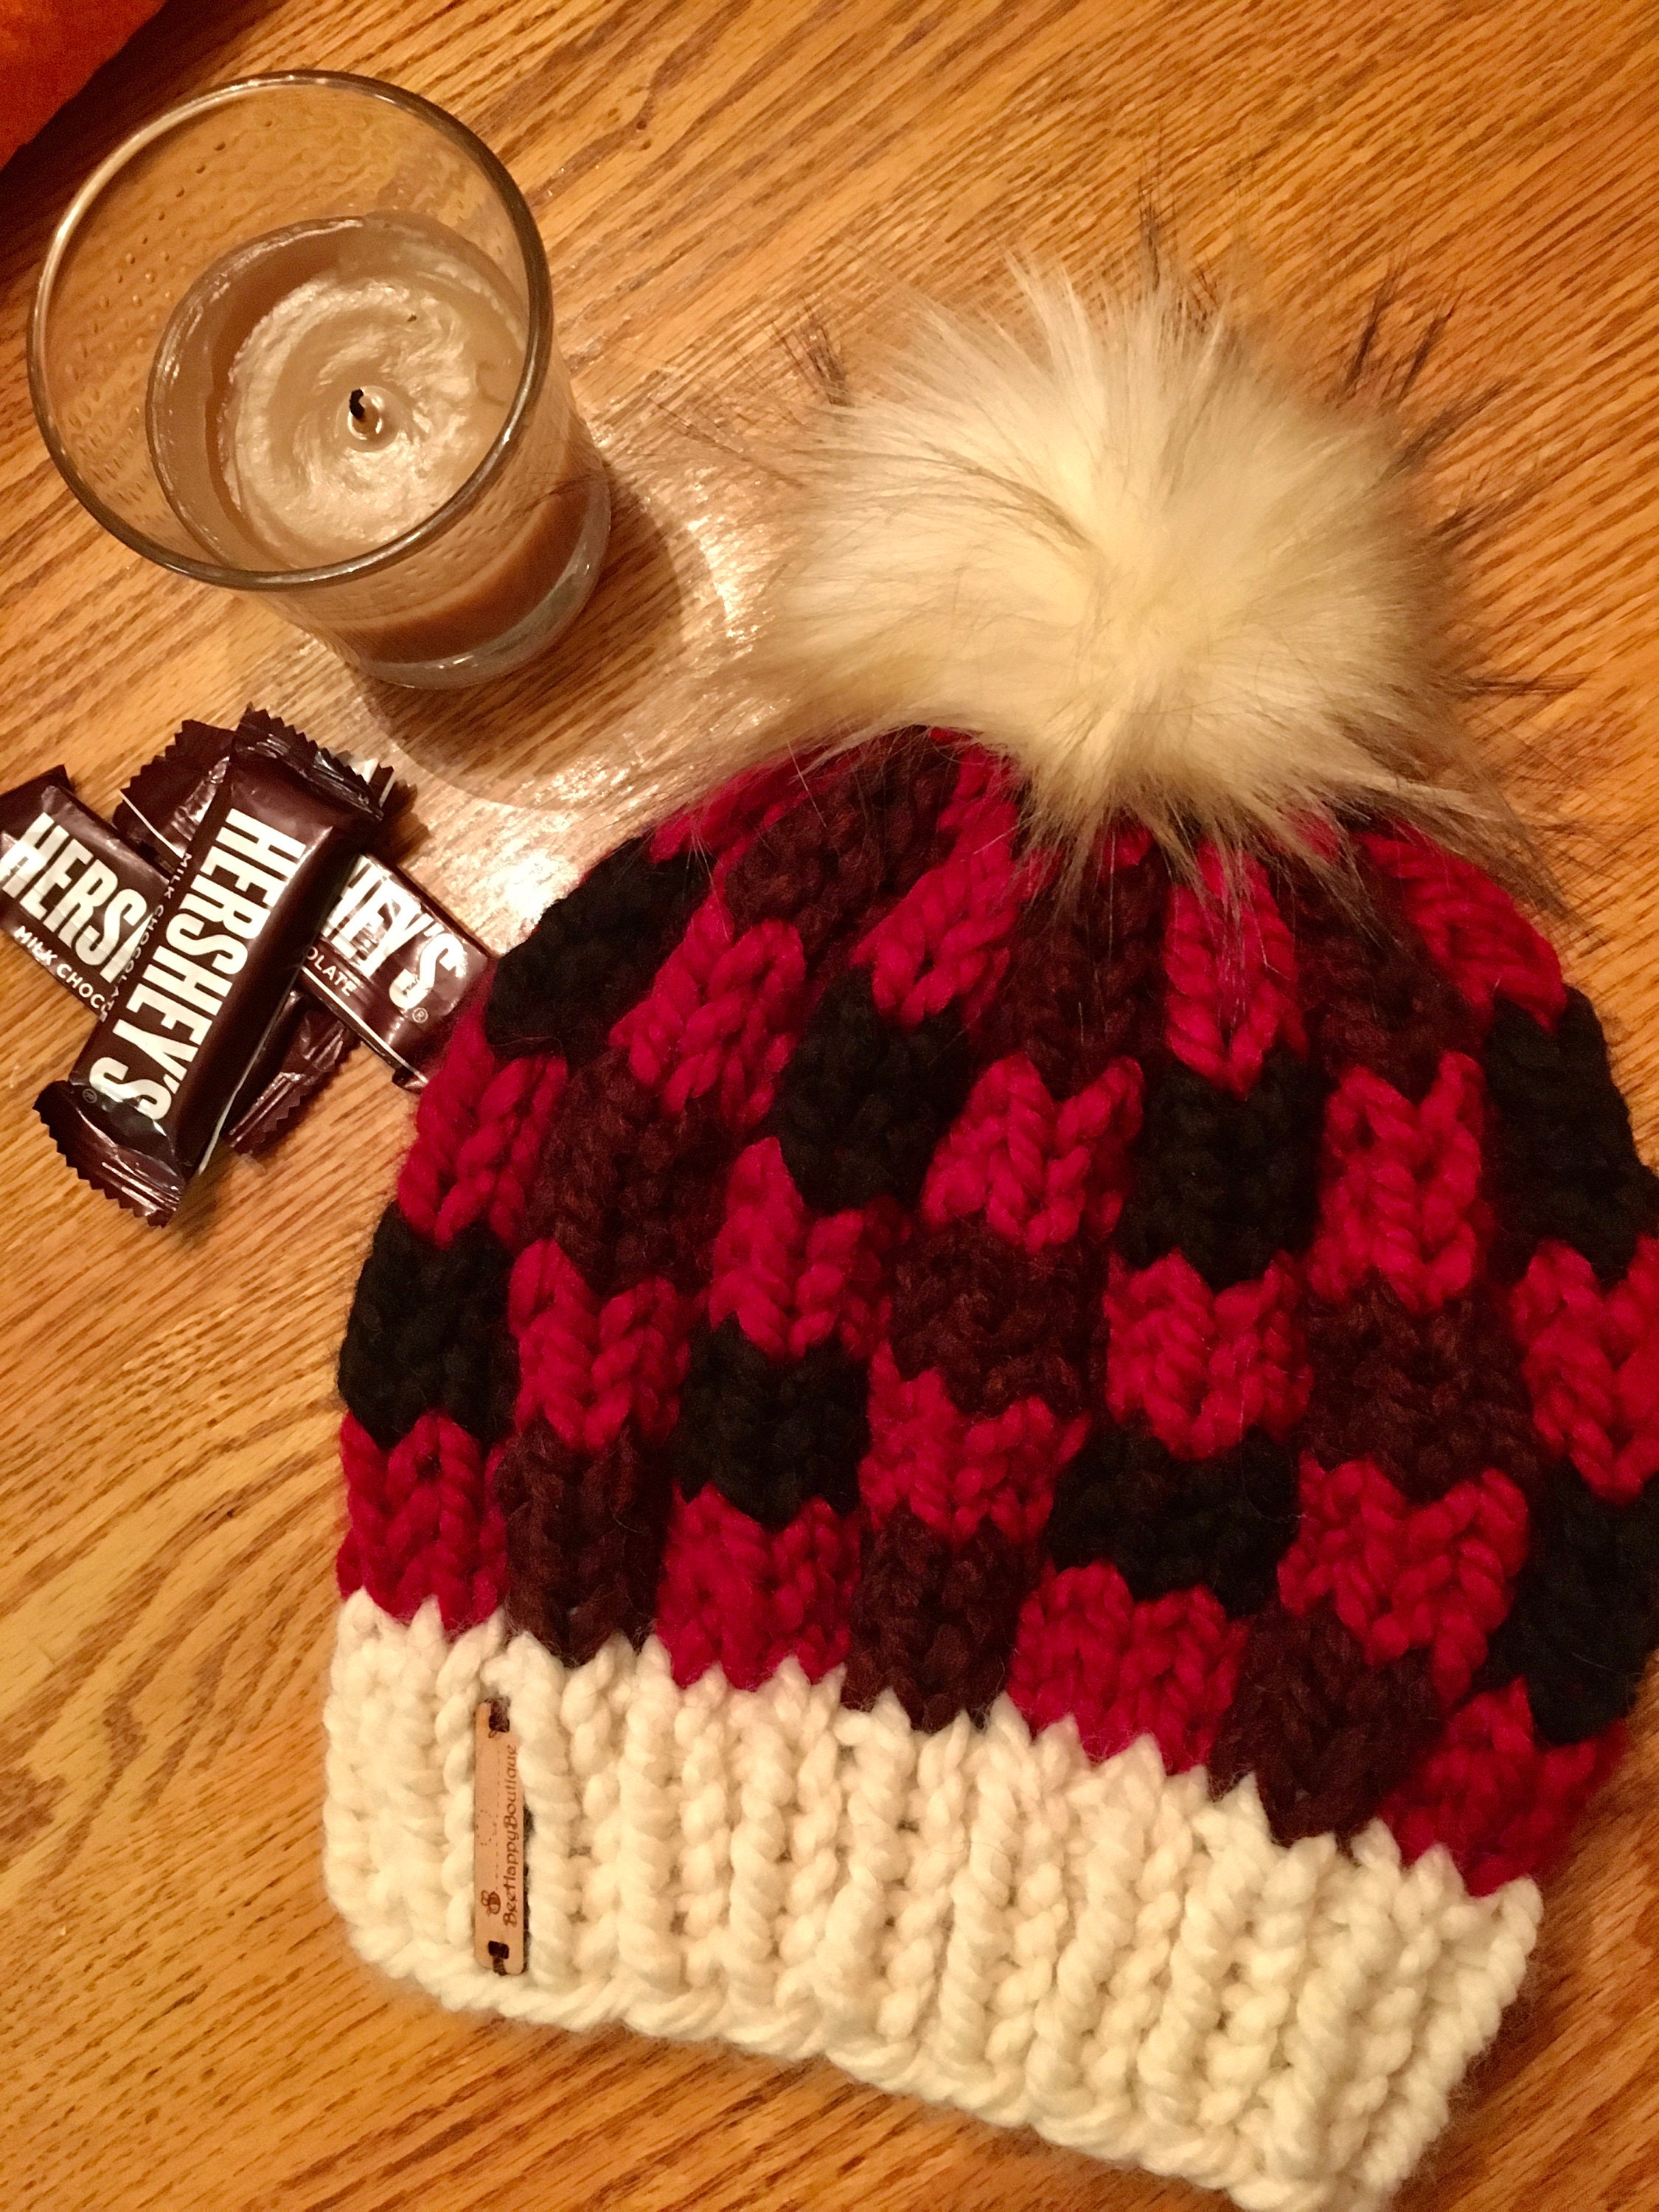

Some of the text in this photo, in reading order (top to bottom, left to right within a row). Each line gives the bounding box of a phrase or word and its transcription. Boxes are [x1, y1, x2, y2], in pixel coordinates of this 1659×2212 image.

[164, 852, 192, 899] MILK
[13, 925, 58, 966] MILK
[89, 808, 307, 1120] HERSHEY'S
[503, 1745, 520, 1927] BeeHappyBoutique
